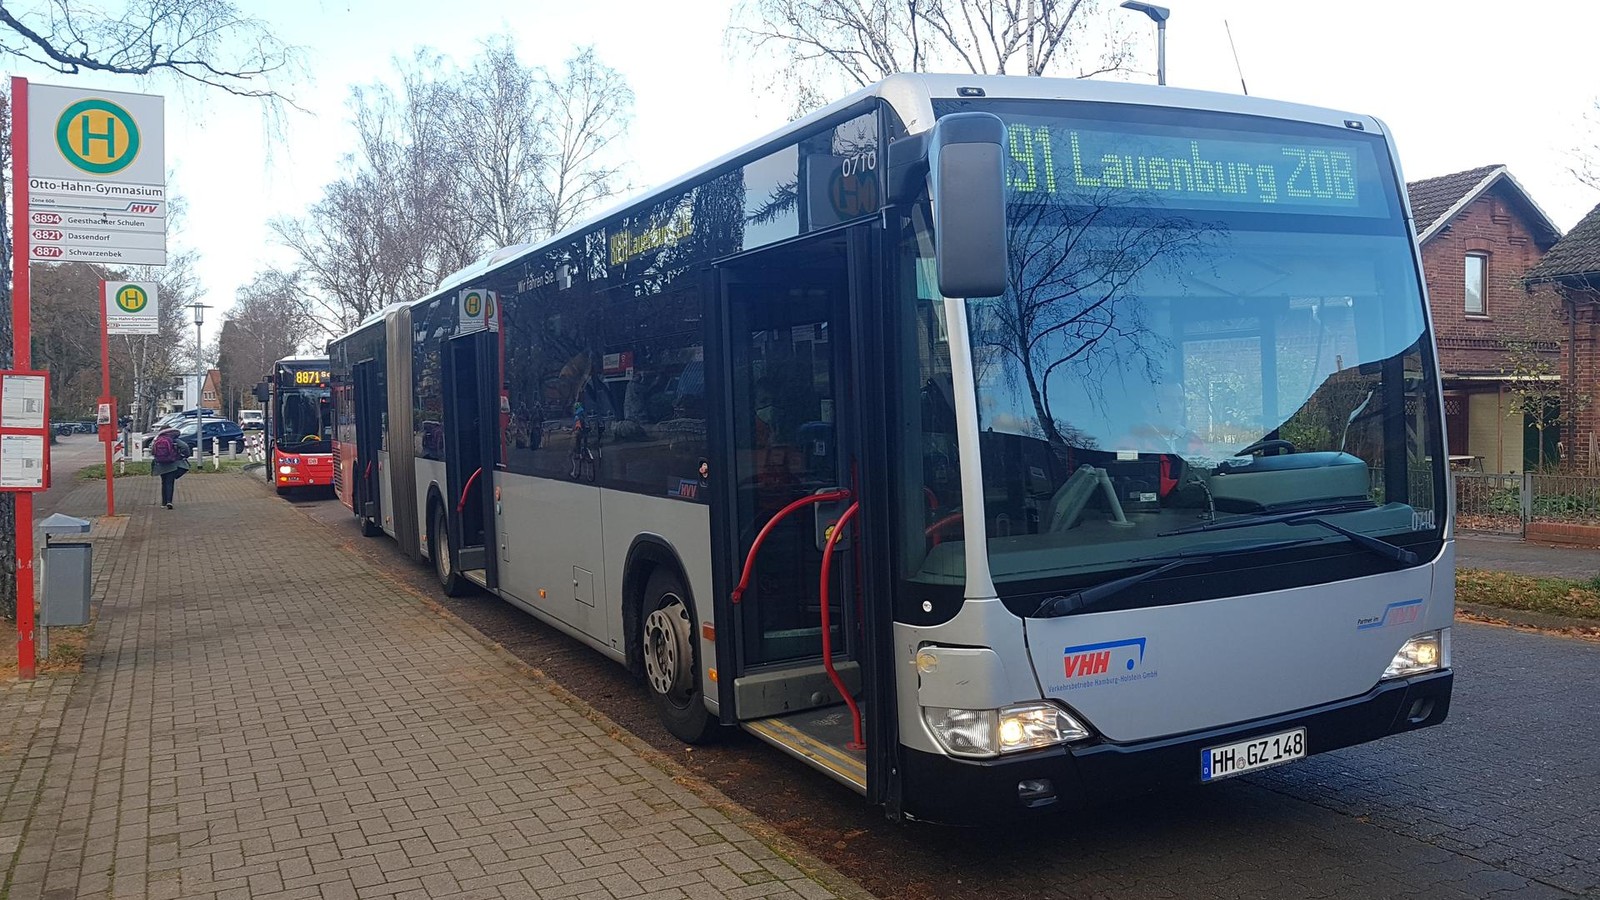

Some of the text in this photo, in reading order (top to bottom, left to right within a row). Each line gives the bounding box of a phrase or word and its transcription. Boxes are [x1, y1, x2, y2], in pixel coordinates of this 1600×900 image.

[82, 115, 115, 158] H
[842, 150, 876, 177] 0710
[1006, 123, 1356, 203] 91 Lauenburg ZOB
[30, 179, 163, 197] Otto-Hahn-Gymnasium
[131, 204, 158, 213] HVV
[34, 214, 145, 227] 8894 Geesthachter Schulen
[35, 230, 110, 241] 8821 Dassendorf
[36, 247, 122, 258] 8871 Schwarzenbek
[296, 371, 320, 384] 8871
[1064, 651, 1110, 678] VHH
[1048, 681, 1094, 693] Verkehrsbetriebe
[1142, 671, 1158, 680] GmbH
[1212, 748, 1235, 774] HH
[1247, 740, 1269, 766] GZ
[1273, 733, 1303, 760] 148
